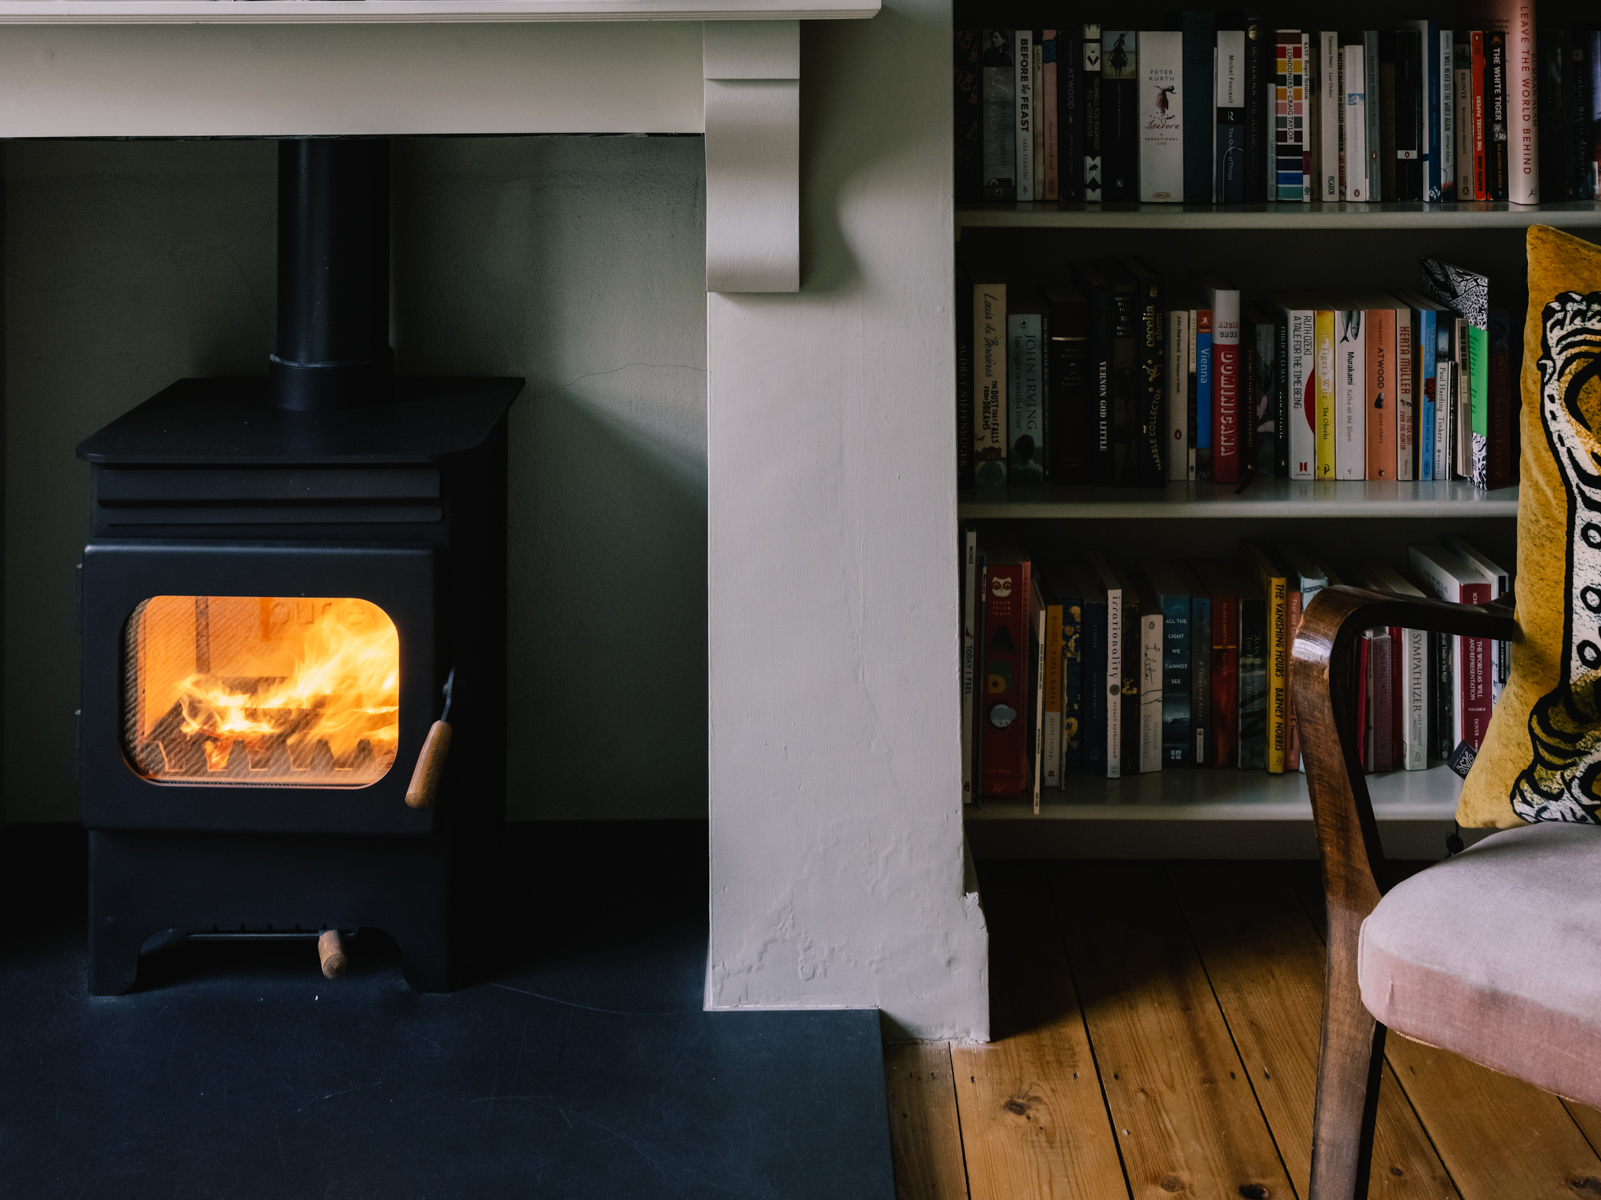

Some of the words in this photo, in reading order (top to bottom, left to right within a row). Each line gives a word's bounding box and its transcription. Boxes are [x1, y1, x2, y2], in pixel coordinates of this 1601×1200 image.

[1520, 6, 1529, 43] LEAVE
[1020, 38, 1028, 82] BEFORE
[1521, 50, 1529, 72] THE
[1021, 84, 1031, 94] the
[1493, 67, 1501, 94] WHITE
[1020, 96, 1029, 132] FEAST
[1494, 96, 1502, 121] TIGER
[1522, 78, 1530, 122] WORLD
[1523, 128, 1531, 175] BEHIND
[1303, 315, 1312, 336] RUTH
[1400, 326, 1410, 355] HERTA
[1023, 334, 1036, 373] JOHN
[1303, 336, 1312, 356] OZEKI
[1099, 361, 1107, 397] VERNON
[1200, 348, 1210, 384] Vienna
[1401, 358, 1411, 394] MÜLLER
[1438, 367, 1446, 381] Paul
[990, 390, 999, 408] DUST
[1026, 378, 1037, 430] IRVING
[1099, 400, 1107, 418] GOD
[1220, 351, 1235, 456] DOMINICANA
[1437, 384, 1445, 412] Harding
[982, 400, 990, 430] DREAMS
[990, 422, 999, 444] FALLS
[1099, 421, 1107, 451] LITTLE
[1275, 584, 1284, 600] THE
[1108, 596, 1120, 679] irrationality
[1275, 603, 1284, 648] VANISHING
[1144, 644, 1160, 686] Lolita
[1275, 651, 1284, 678] HOURS
[1412, 634, 1422, 712] SYMPATHIZER
[1275, 688, 1284, 719] BARNEY
[1143, 714, 1152, 759] Nabokov
[1275, 721, 1284, 752] NORRIS
